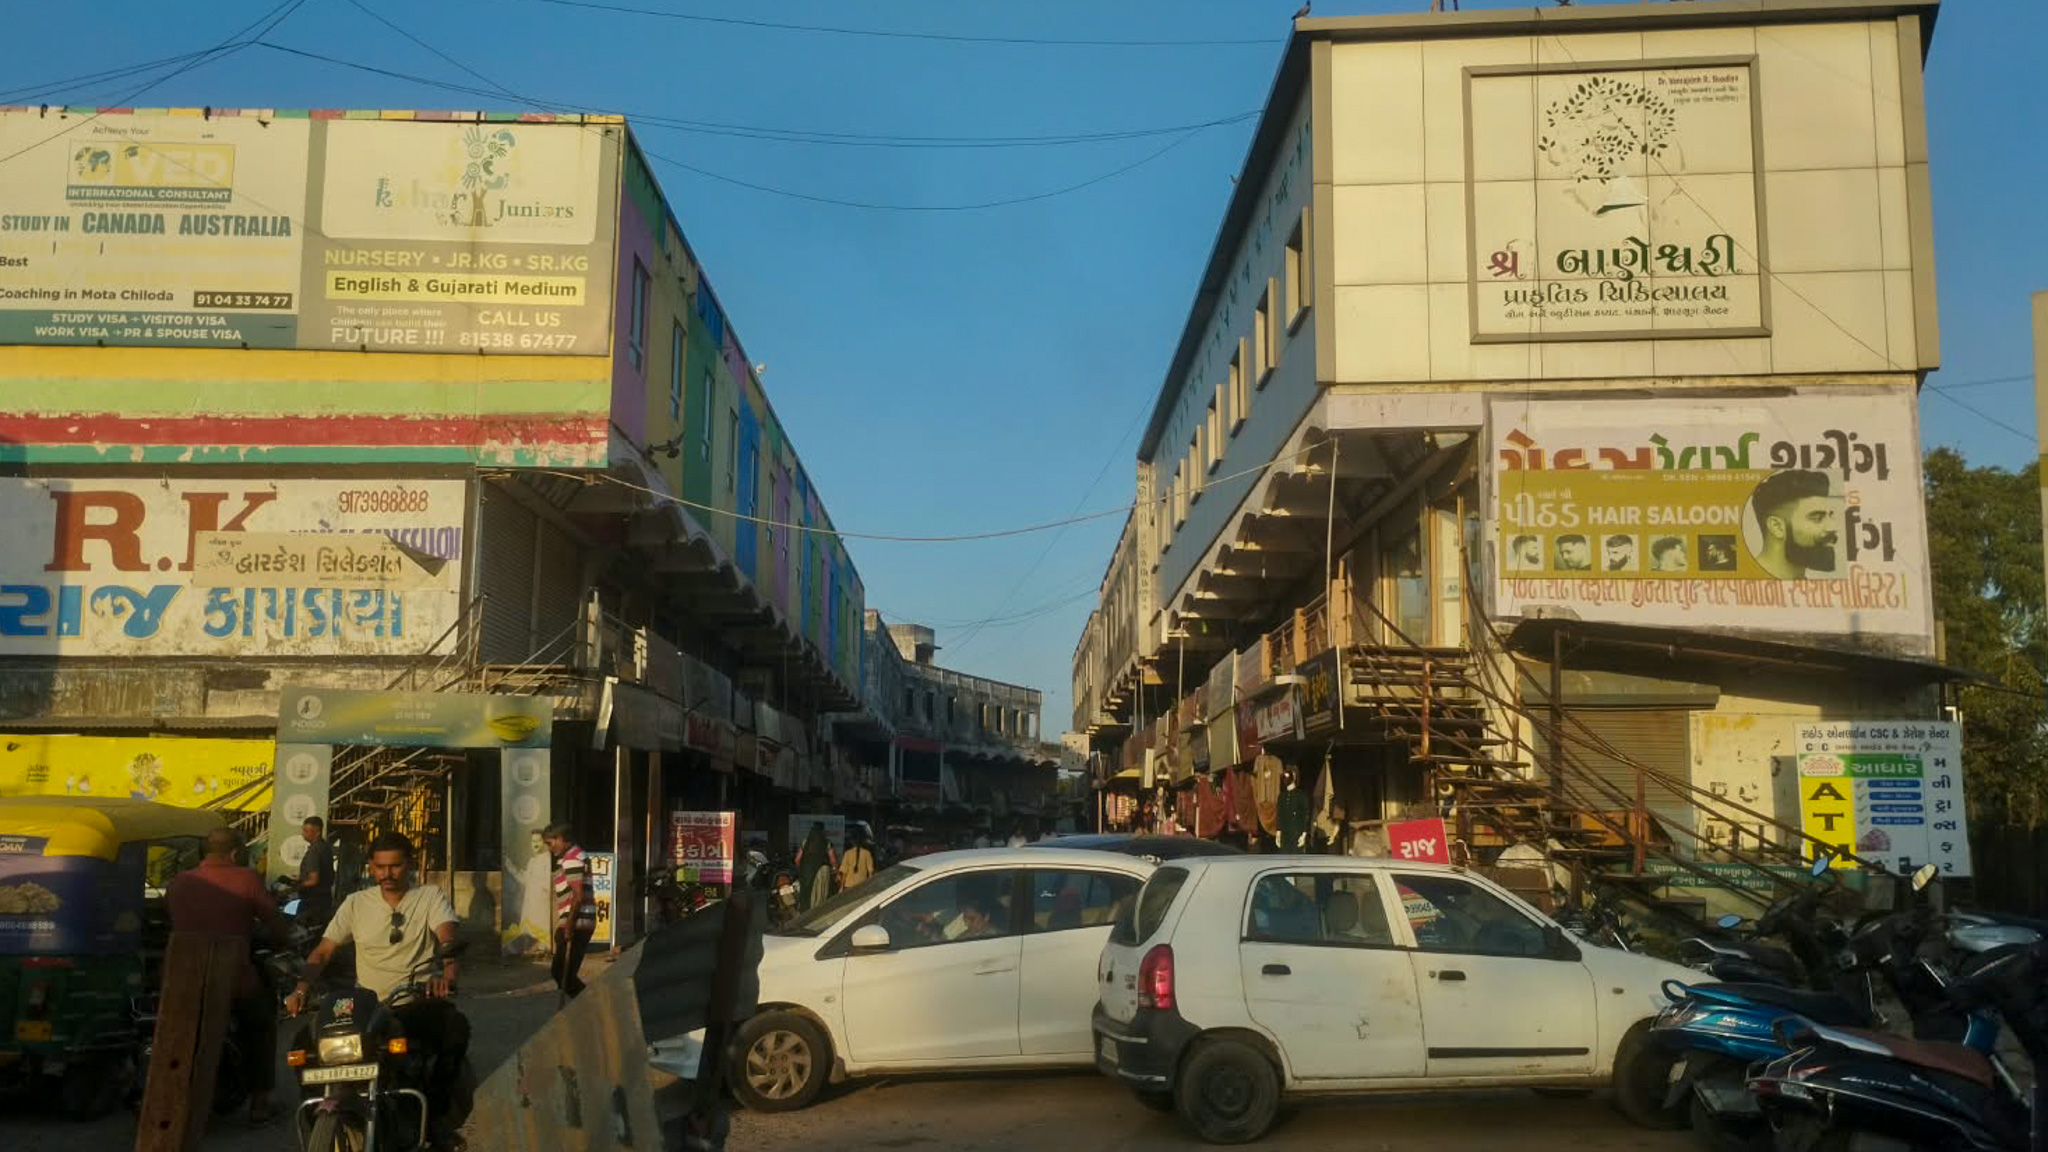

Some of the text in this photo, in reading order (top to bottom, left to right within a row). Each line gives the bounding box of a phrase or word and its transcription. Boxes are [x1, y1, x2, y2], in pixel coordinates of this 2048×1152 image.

[131, 127, 149, 135] Your
[68, 187, 230, 200] INTERNATIONAL CONSULTANT
[1, 212, 292, 237] STUDY IN CANADA AUSTRALIA
[0, 256, 29, 268] Best
[325, 249, 589, 272] NURSERY JR.KG SR.KG
[334, 276, 578, 297] English & Gujarati Medium
[0, 289, 174, 302] Coaching in Mota Chiloda
[197, 294, 289, 306] 91 04 33 74 77
[52, 313, 227, 326] STUDY VISA VISITOR VISA
[478, 311, 561, 328] CALL US
[35, 326, 242, 340] WORK VISA PR & SPOUSE VISA
[331, 327, 445, 346] FUTURE !!!
[459, 332, 578, 349] 81538 67477
[1587, 505, 1642, 526] HAIR
[1646, 505, 1740, 526] SALOON
[0, 585, 184, 638] રાજ
[1870, 728, 1889, 739] CSC
[1892, 729, 1899, 738] &
[1851, 762, 1918, 774] આધાર
[1807, 782, 1851, 862] ATM
[1400, 836, 1437, 859] રાજ
